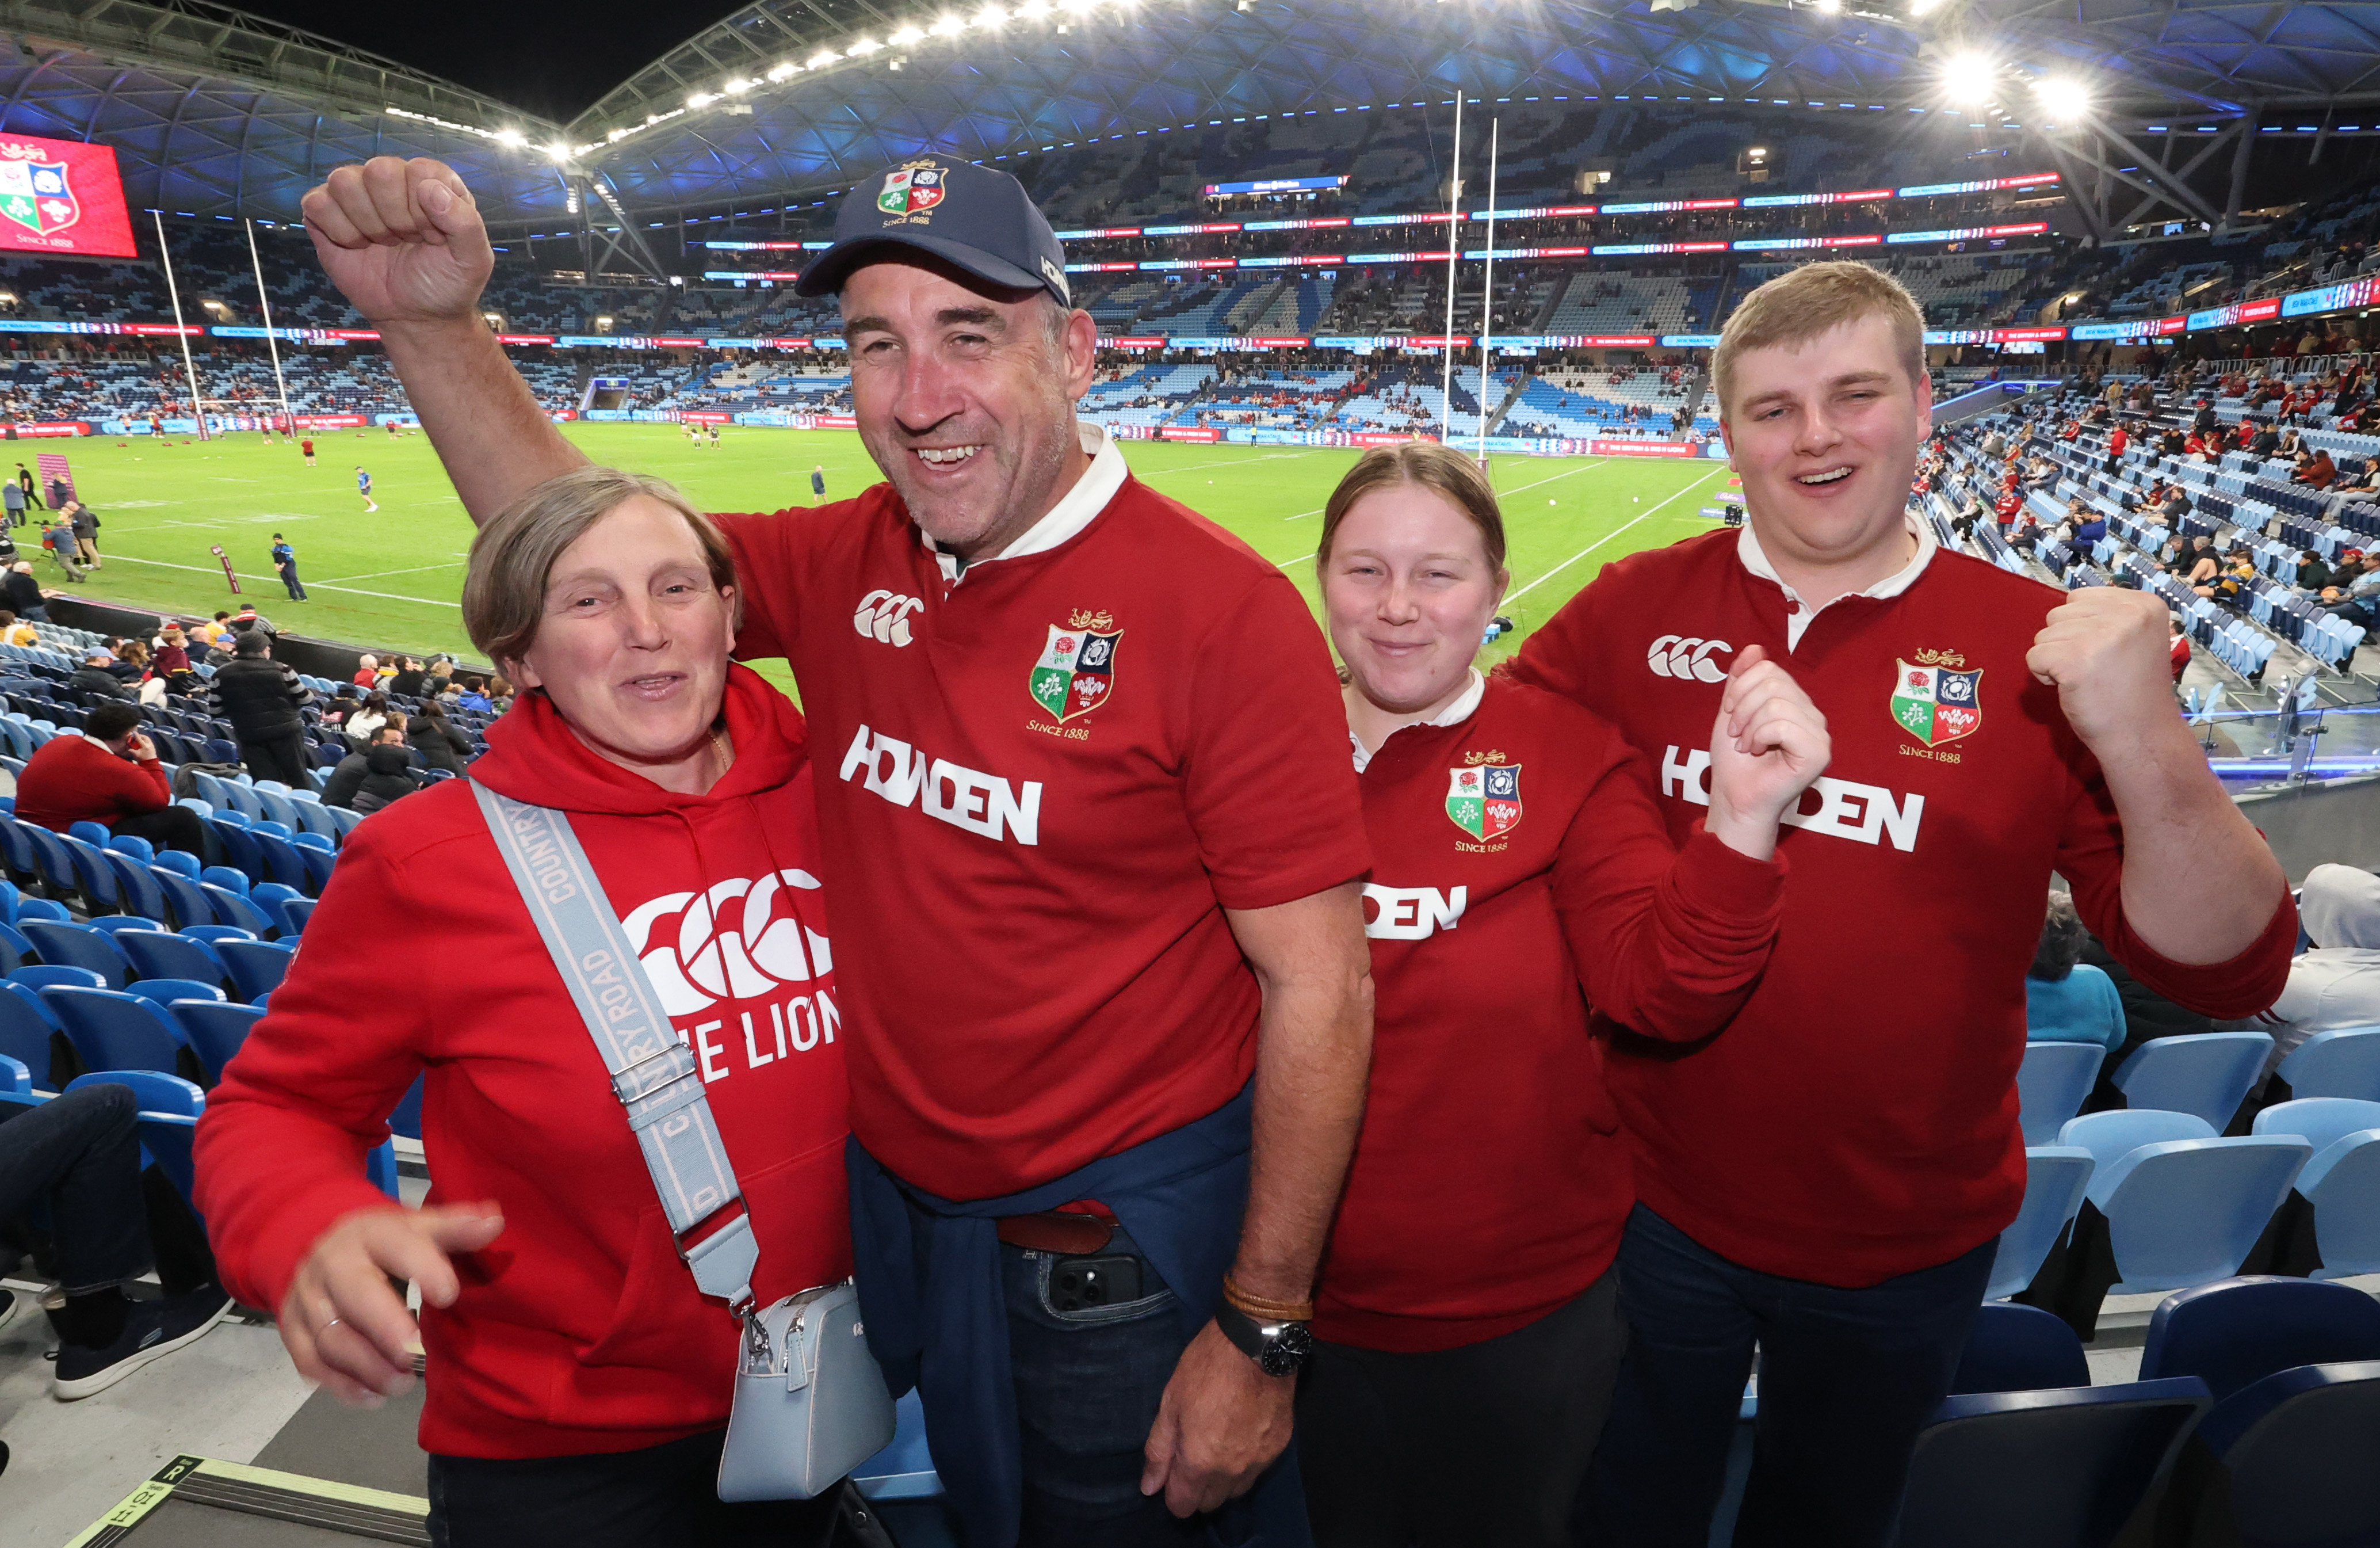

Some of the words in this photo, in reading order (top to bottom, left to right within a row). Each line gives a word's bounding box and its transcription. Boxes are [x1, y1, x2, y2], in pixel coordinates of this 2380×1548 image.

[882, 218, 907, 228] SINCE
[910, 216, 930, 225] 1888
[16, 234, 48, 246] SINCE
[50, 238, 74, 249] 1888
[1026, 720, 1063, 737] SINCE
[1064, 728, 1090, 741] 1888
[1899, 744, 1934, 759] SINCE
[1935, 752, 1961, 764] 1888
[840, 724, 1042, 845] HOWDEN
[1662, 745, 1925, 853] HDEN
[506, 804, 576, 905] COUNTRY
[1455, 841, 1486, 853] SINCE
[1488, 842, 1508, 853] 1888
[1360, 882, 1467, 940] DEN
[582, 949, 638, 1023] ROAD
[740, 986, 842, 1069] LION
[617, 1025, 690, 1138] CUNTRY
[163, 1465, 185, 1481] R
[133, 1492, 156, 1504] 01
[110, 1509, 133, 1522] 11
